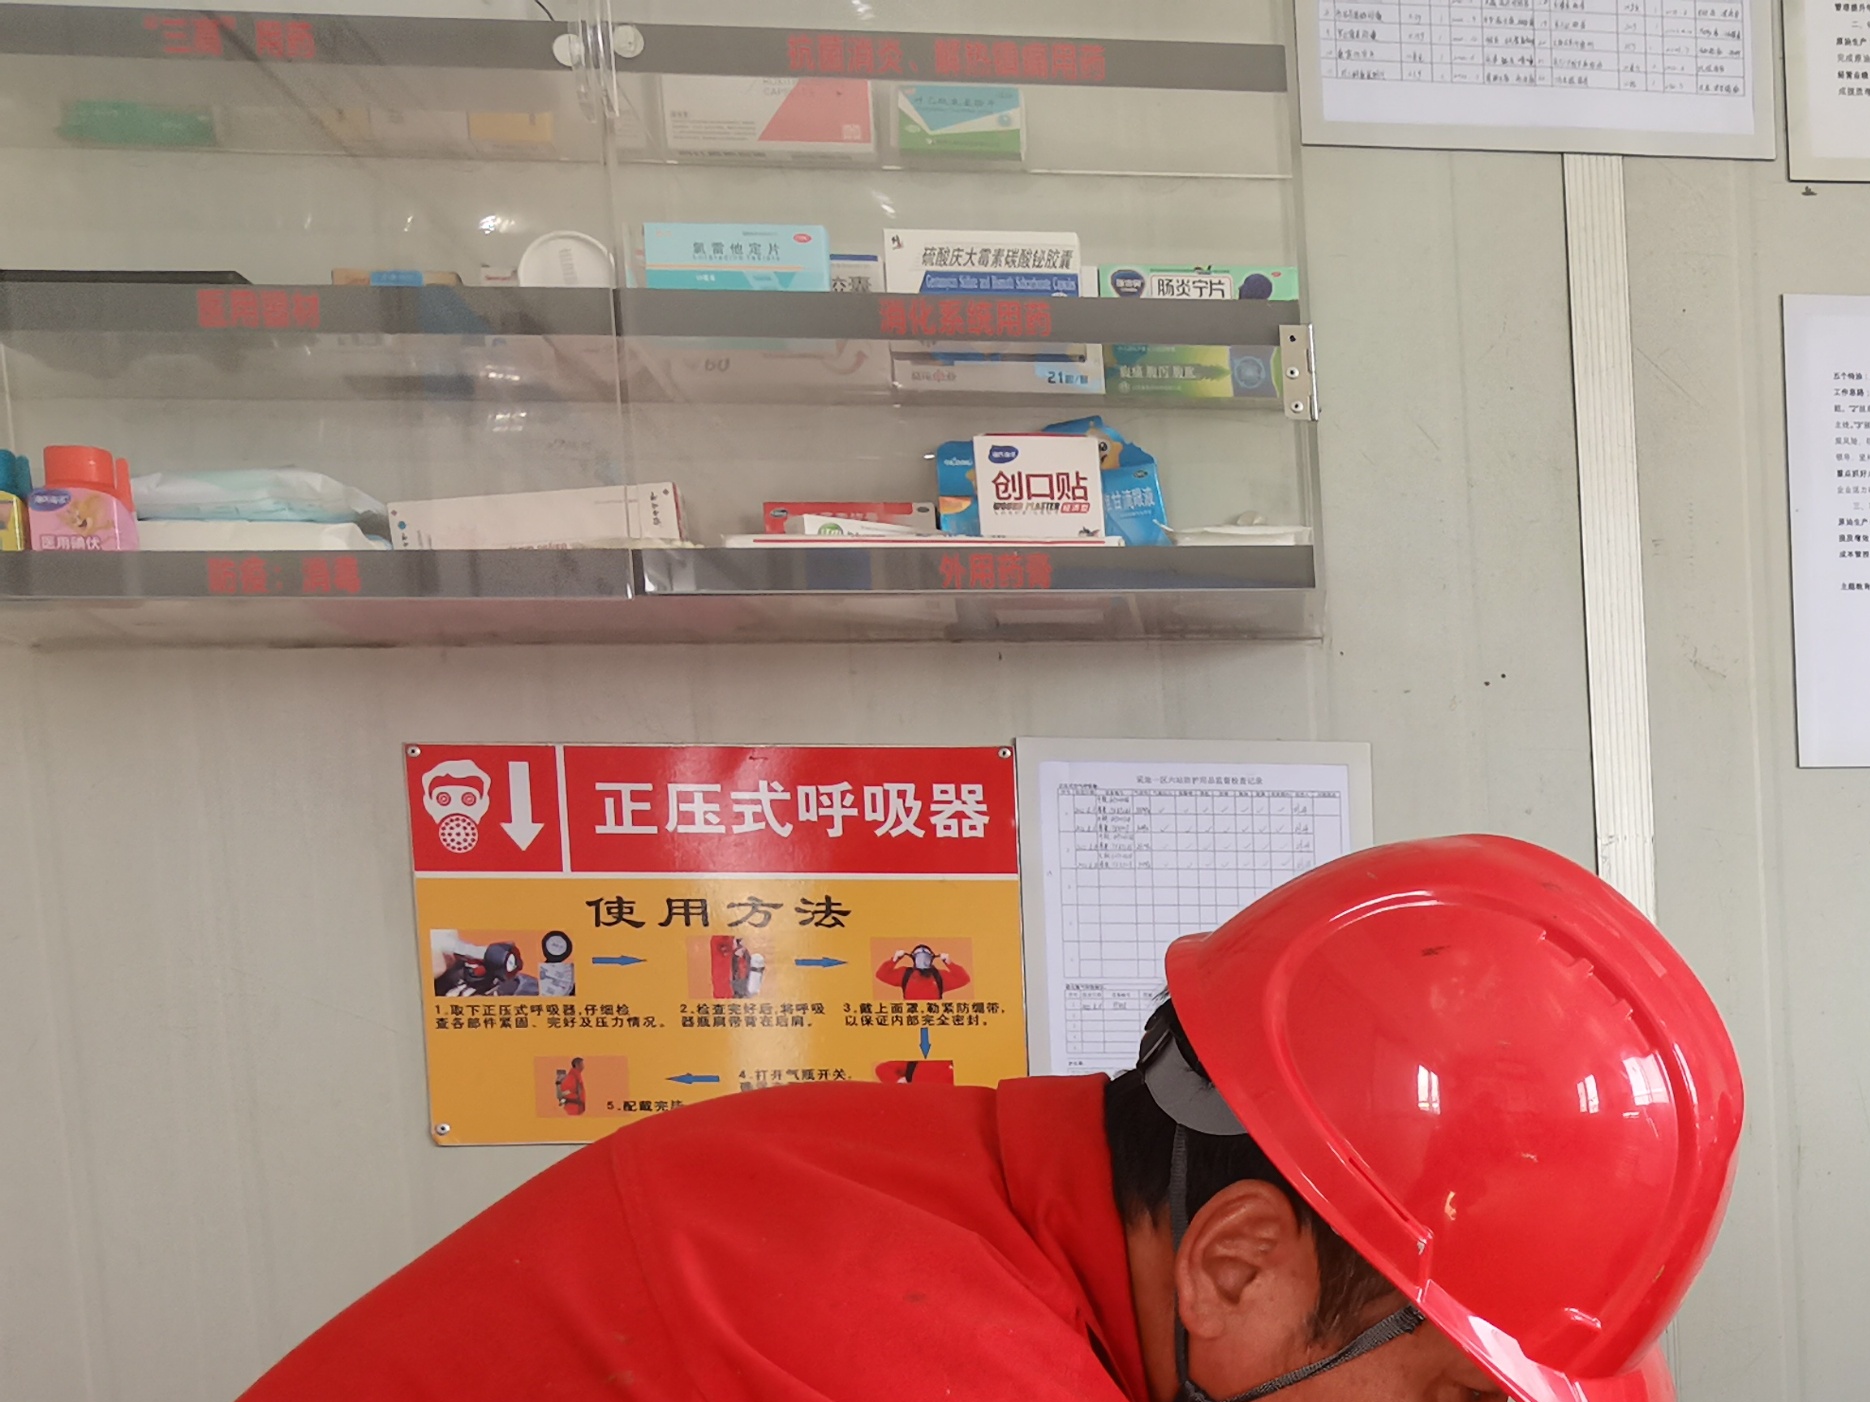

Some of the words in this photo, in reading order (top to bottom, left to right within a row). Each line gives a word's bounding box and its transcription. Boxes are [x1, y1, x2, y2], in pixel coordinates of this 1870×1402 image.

[922, 246, 1074, 269] 硫酸庆大霉素碳酸铋胶囊
[1157, 277, 1226, 298] 肠炎宁片
[879, 298, 1053, 337] 消化系统用药
[991, 470, 1088, 501] 创口贴
[939, 552, 1053, 590] 外用药膏
[595, 780, 991, 839] 正压式呼吸器
[585, 895, 852, 929] 使用方法
